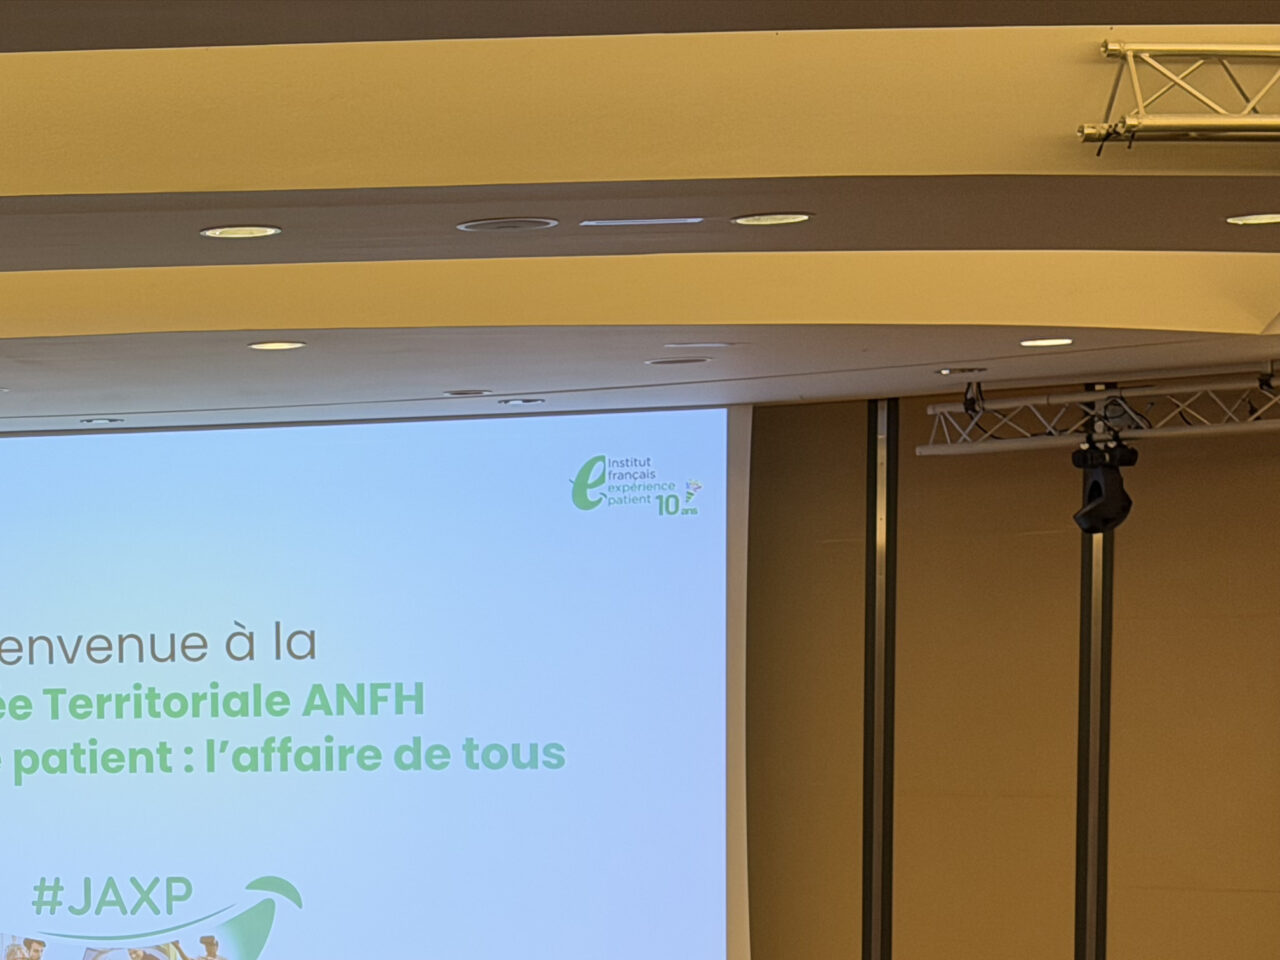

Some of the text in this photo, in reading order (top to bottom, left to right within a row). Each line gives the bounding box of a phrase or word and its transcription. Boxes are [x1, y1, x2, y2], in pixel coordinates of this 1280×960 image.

[607, 457, 651, 468] Institut
[607, 469, 656, 481] français
[607, 481, 676, 493] expérience
[607, 495, 651, 506] patient
[655, 494, 698, 516] 10 ans
[224, 620, 255, 662] à
[274, 621, 316, 661] la
[41, 681, 292, 721] Territoriale
[300, 682, 424, 718] ANFH
[13, 737, 173, 787] patient
[393, 736, 452, 772] de
[461, 736, 567, 771] tous
[31, 876, 193, 916] #JAXP
